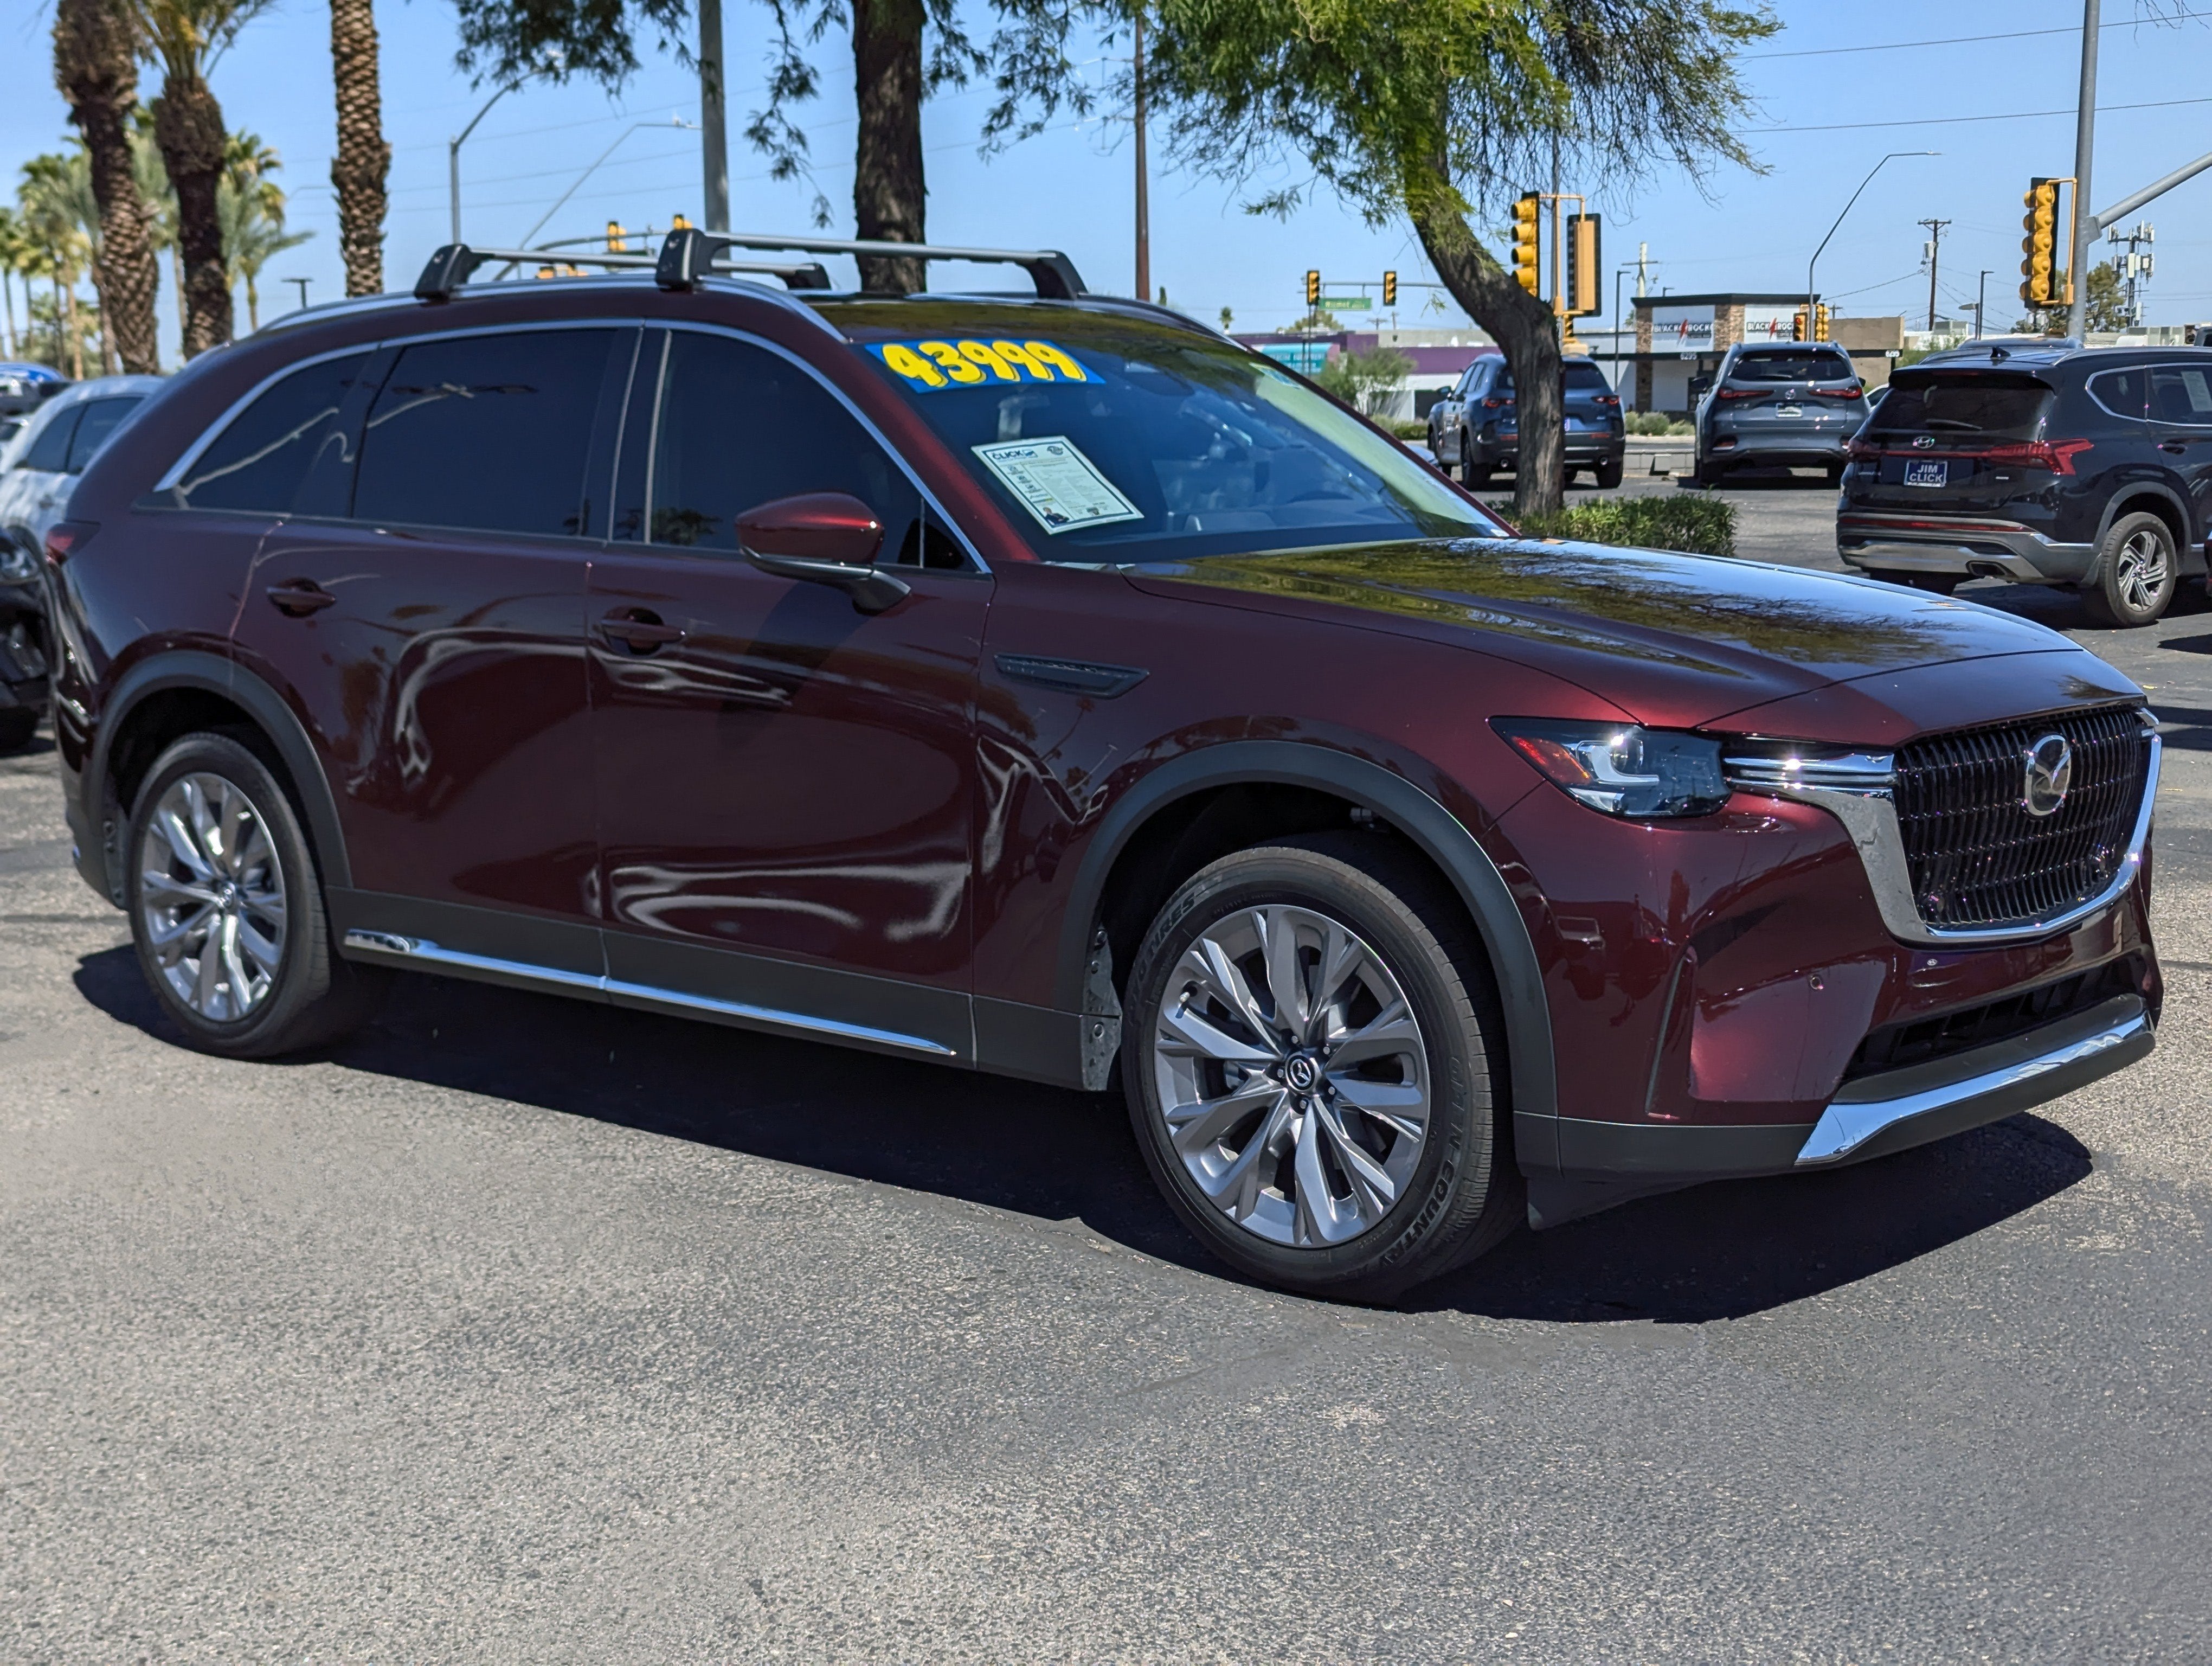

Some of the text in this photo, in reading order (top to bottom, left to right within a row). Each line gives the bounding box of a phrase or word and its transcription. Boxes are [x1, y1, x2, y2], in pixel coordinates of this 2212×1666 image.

[1654, 324, 1710, 333] BLACK ROCK
[1747, 323, 1770, 331] BLACK
[883, 341, 1086, 387] 43999
[992, 450, 1024, 460] CLICK
[1917, 464, 1938, 473] JIM
[1909, 473, 1943, 482] CLICK
